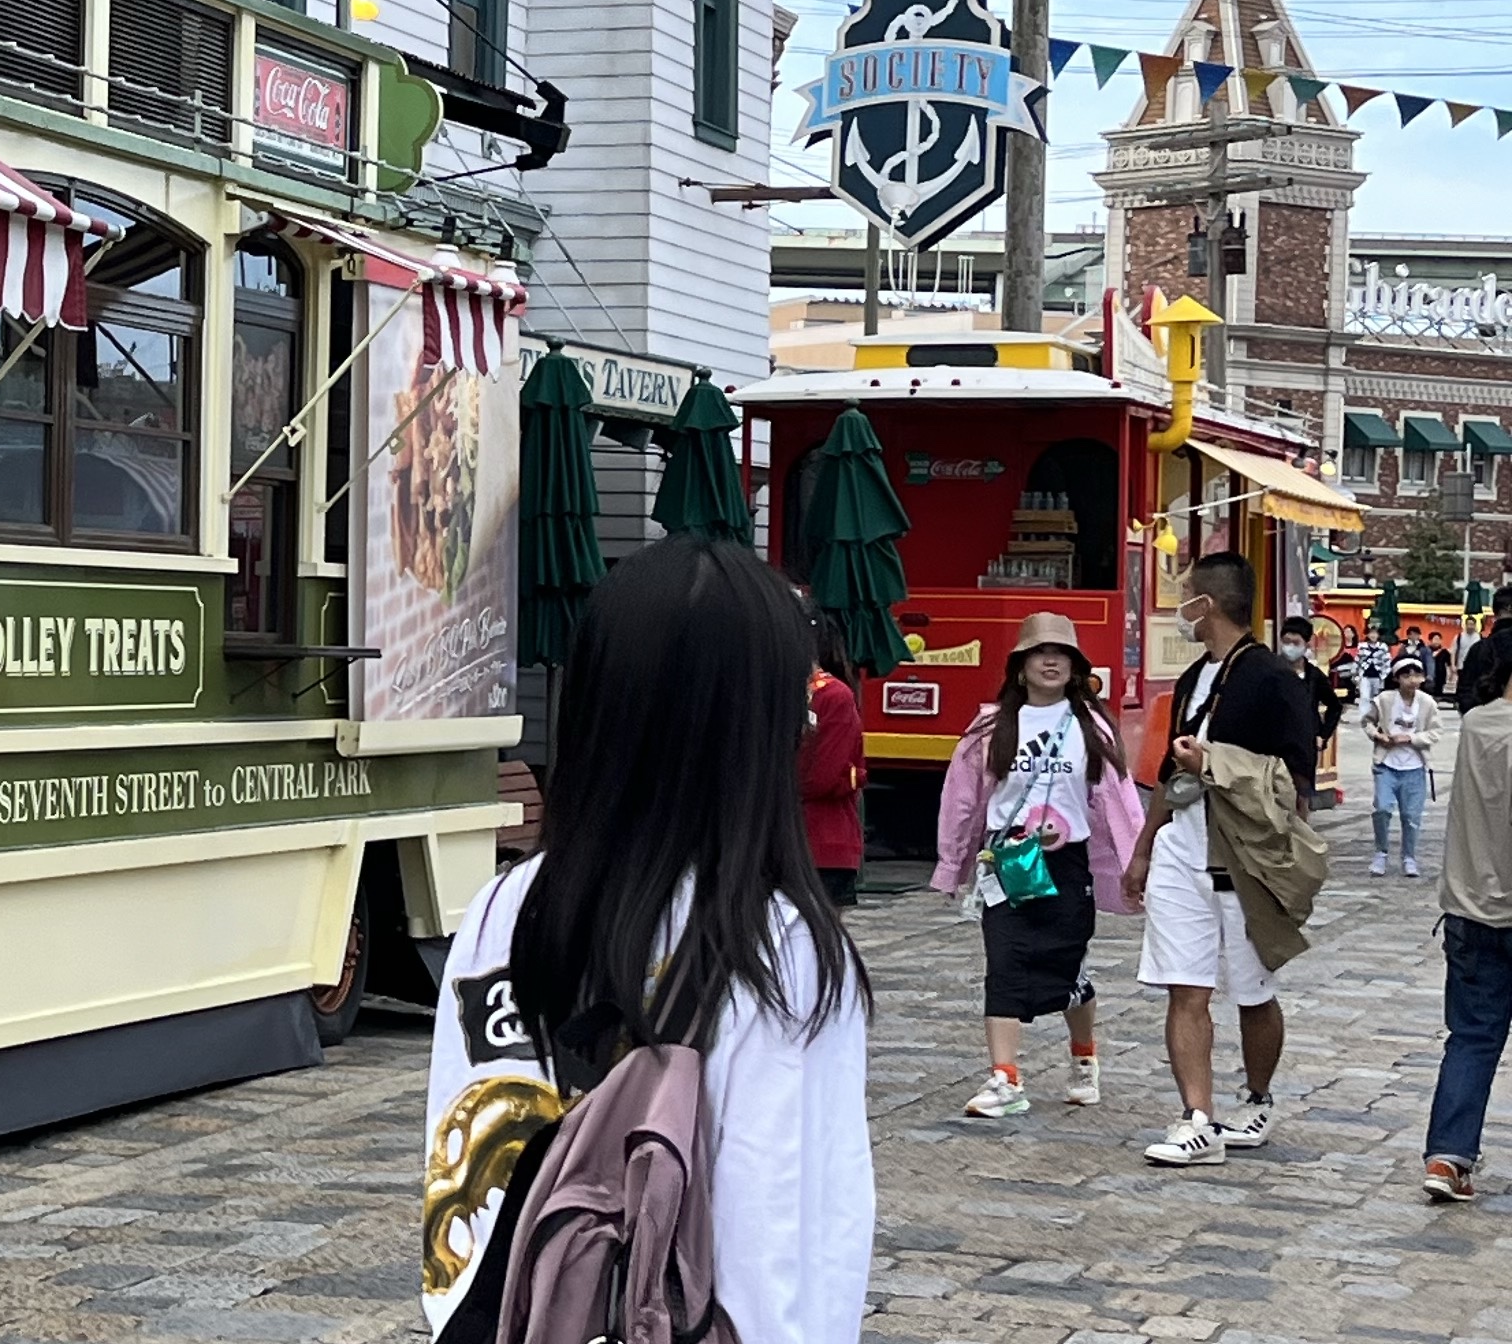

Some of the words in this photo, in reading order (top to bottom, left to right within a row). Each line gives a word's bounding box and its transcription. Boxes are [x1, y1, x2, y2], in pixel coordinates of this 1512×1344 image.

[264, 65, 332, 131] Coca-Cola
[839, 50, 996, 99] SOCIETY
[601, 358, 682, 407] TAVERN
[85, 619, 186, 676] TREATS
[115, 770, 200, 815] STREET
[203, 778, 227, 807] to
[231, 762, 320, 804] CENTRAL
[323, 758, 372, 798] PARK
